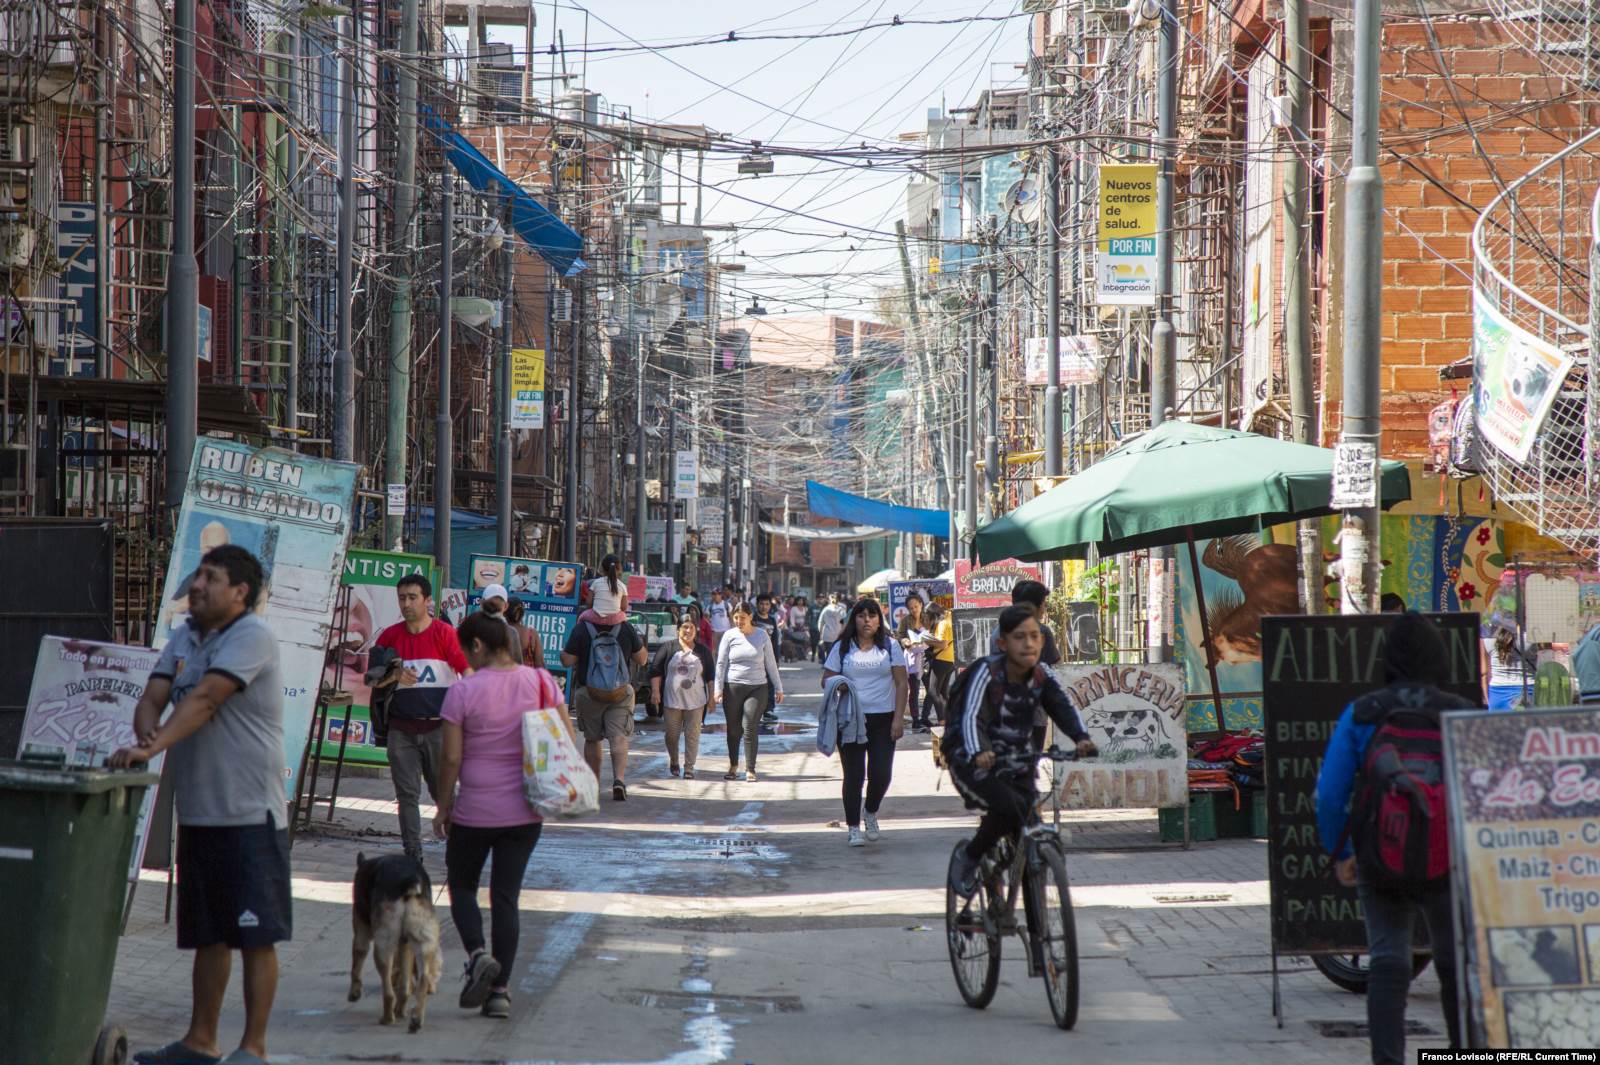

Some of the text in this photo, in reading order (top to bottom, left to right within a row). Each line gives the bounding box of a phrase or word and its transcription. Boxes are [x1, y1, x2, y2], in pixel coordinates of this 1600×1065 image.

[1106, 180, 1152, 190] Nuevos
[1105, 193, 1151, 203] centros
[1105, 206, 1121, 216] de
[1105, 219, 1141, 229] salud.
[1112, 239, 1152, 253] POR FIN
[519, 391, 542, 400] POR FIN
[200, 445, 303, 488] RUBEN
[199, 478, 343, 524] ORLANDO
[344, 557, 425, 578] NTISTA
[893, 586, 910, 596] CON
[60, 650, 88, 662] Todo
[89, 654, 104, 665] en
[1269, 626, 1477, 684] ALMAN
[65, 677, 143, 699] PAPELER
[1067, 666, 1185, 721] RNICERIA
[32, 699, 138, 746] Kiar
[1520, 727, 1600, 761] Alm
[1060, 769, 1170, 805] ANDI
[1477, 828, 1559, 849] Quinua
[1499, 857, 1552, 879] Maiz
[1569, 855, 1600, 875] Ch
[1287, 895, 1366, 921] PAÑAL
